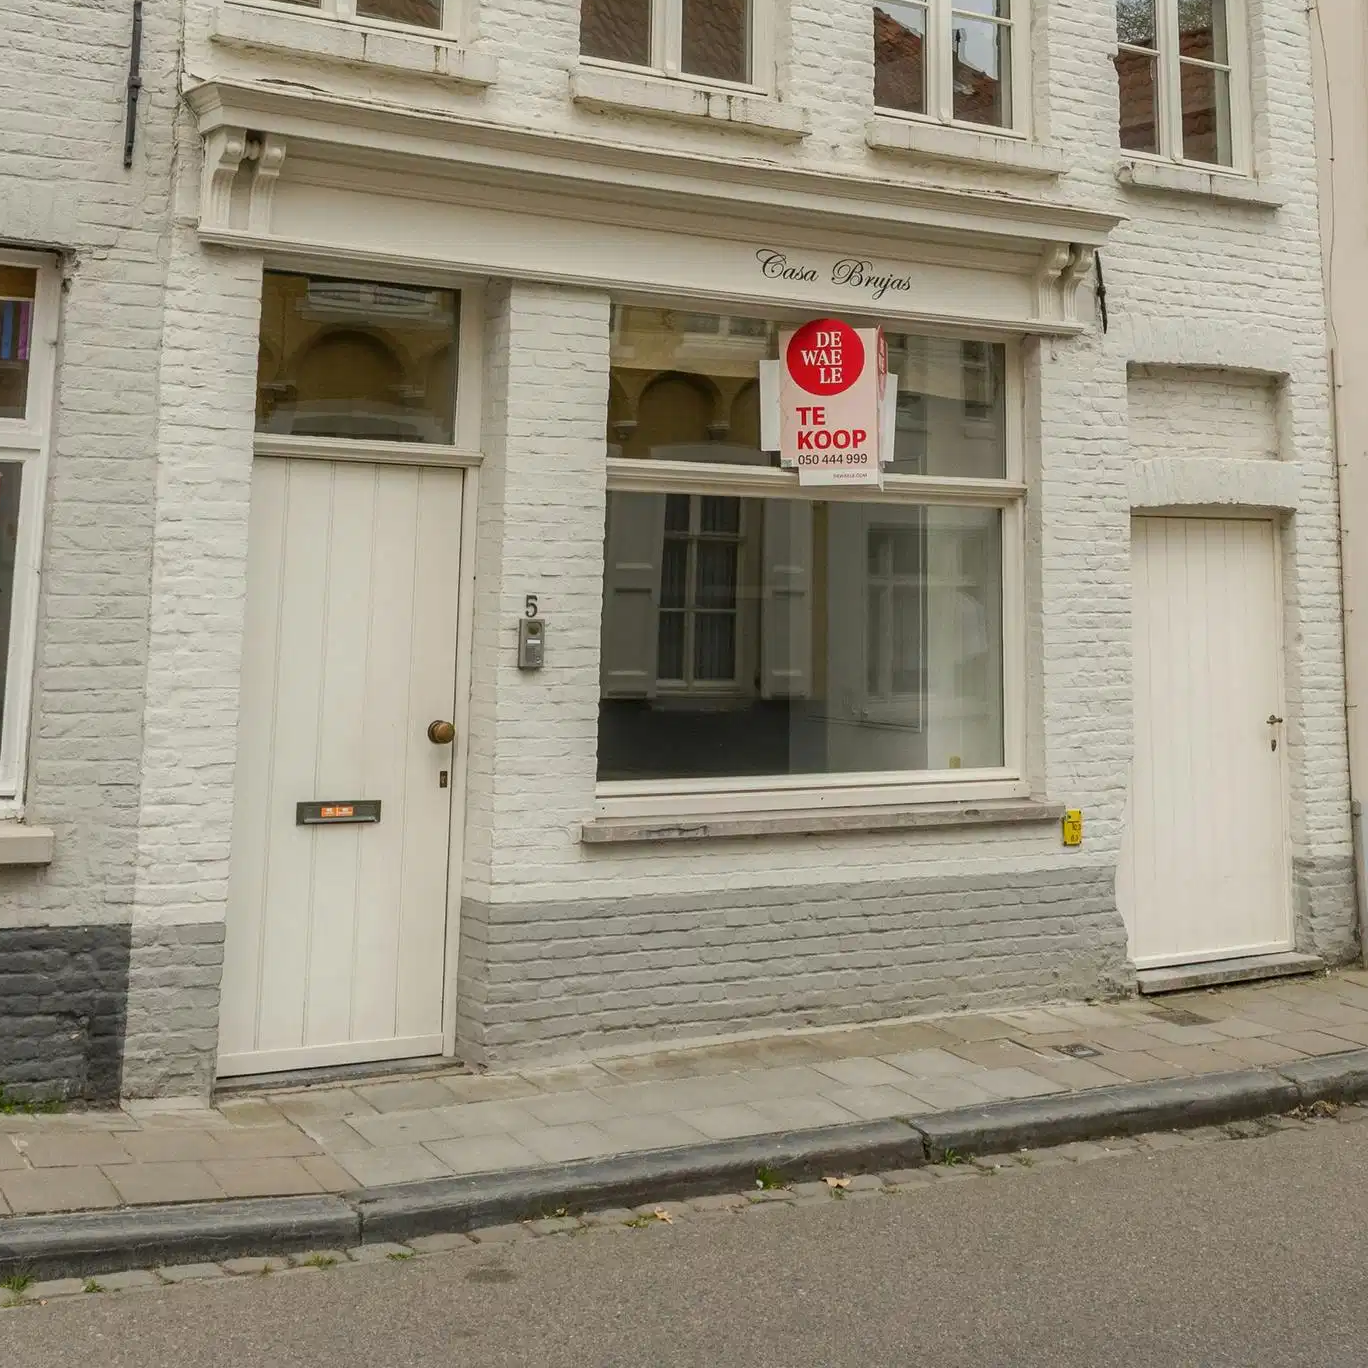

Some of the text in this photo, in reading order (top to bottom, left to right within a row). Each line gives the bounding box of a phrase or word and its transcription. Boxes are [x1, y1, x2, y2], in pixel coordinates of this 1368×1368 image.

[755, 248, 912, 300] Casa Brujas
[816, 331, 842, 348] DE
[800, 349, 843, 366] WAE
[819, 367, 843, 384] LE
[795, 406, 826, 426] TE
[797, 429, 867, 450] KOOP
[798, 453, 868, 465] 050 444 999
[525, 594, 538, 618] 5
